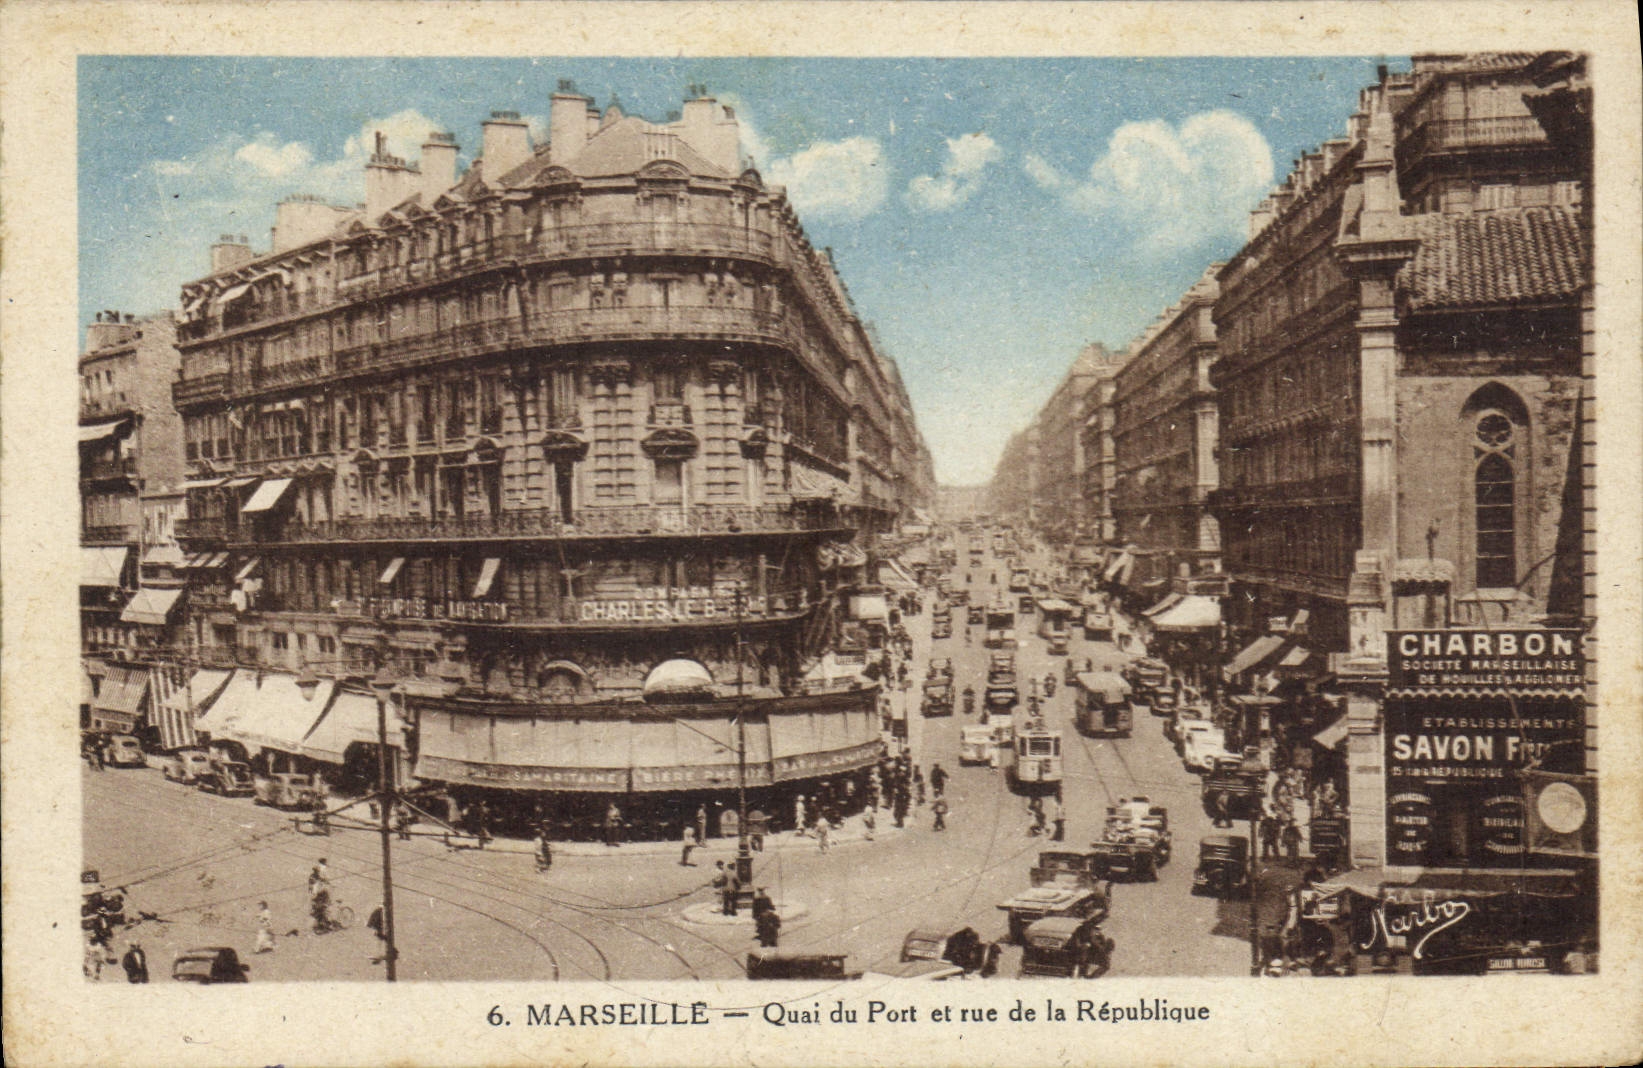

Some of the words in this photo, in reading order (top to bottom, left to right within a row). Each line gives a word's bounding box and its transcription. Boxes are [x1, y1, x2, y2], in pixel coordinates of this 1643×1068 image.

[582, 601, 670, 620] CHARLES
[1471, 660, 1577, 670] MARSEILLAISE
[1394, 734, 1493, 761] SAVON
[513, 771, 617, 784] SAMARITAINE
